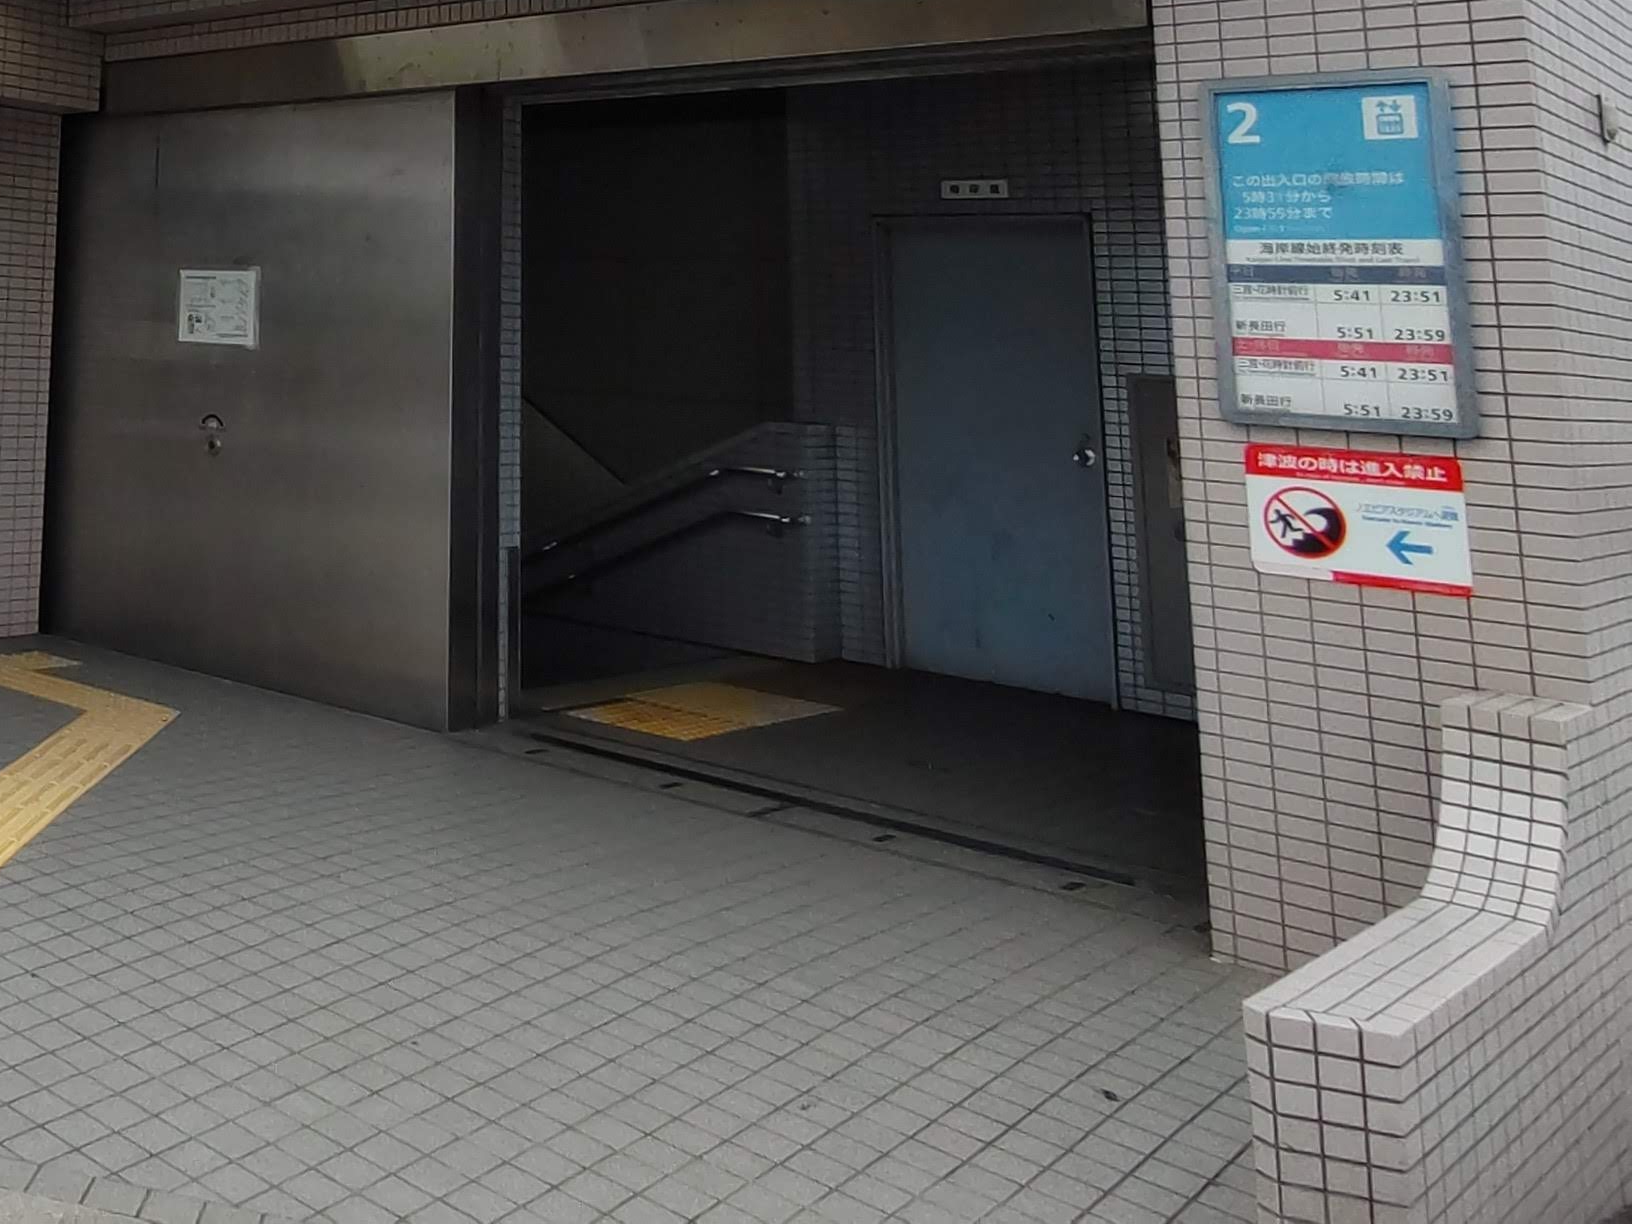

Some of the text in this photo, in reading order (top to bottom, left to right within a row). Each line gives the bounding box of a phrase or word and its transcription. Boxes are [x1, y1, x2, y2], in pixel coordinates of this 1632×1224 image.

[1226, 102, 1261, 144] 2
[1333, 289, 1371, 302] 5:41
[1390, 290, 1441, 303] 23:51
[1336, 326, 1374, 340] 5:51
[1394, 327, 1446, 342] 23:59
[1340, 365, 1377, 378] 5:41
[1397, 367, 1449, 382] 23:51
[1343, 403, 1381, 417] 5:51
[1401, 406, 1453, 421] 23:59
[1258, 451, 1448, 483] 津波の時は進入禁止
